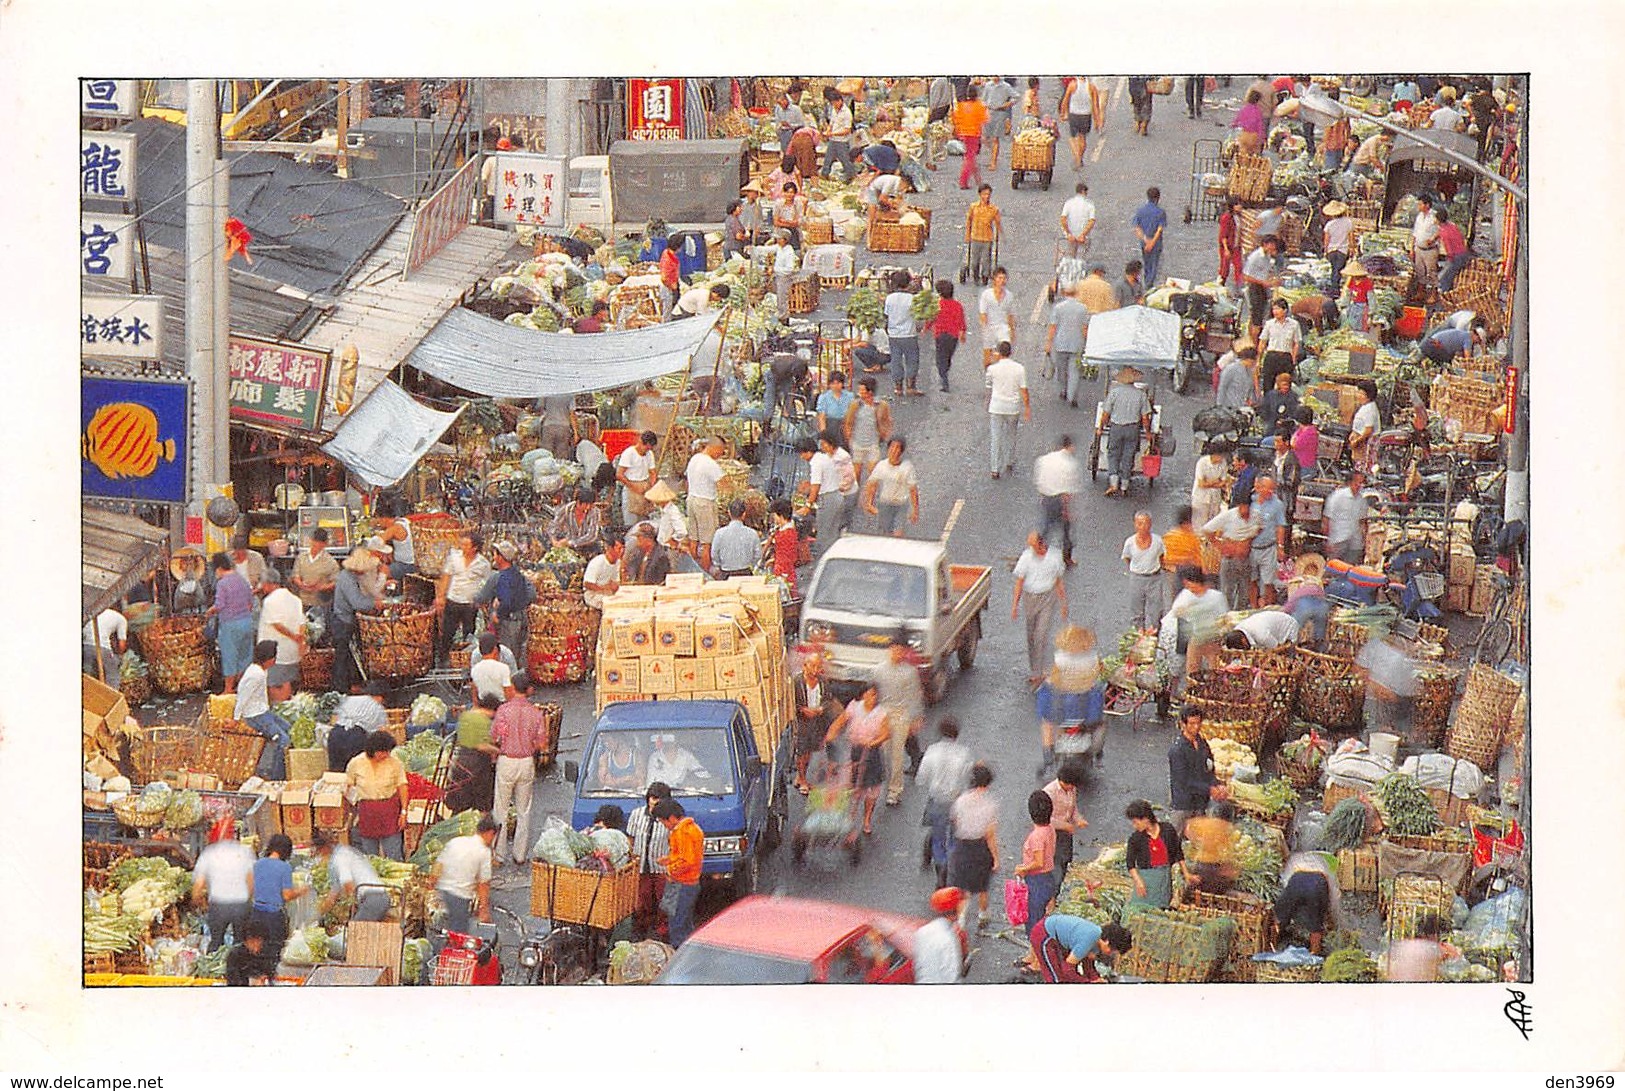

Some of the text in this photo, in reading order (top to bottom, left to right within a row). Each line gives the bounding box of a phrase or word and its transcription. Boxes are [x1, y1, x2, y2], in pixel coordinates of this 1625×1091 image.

[643, 85, 671, 122] 園
[503, 169, 519, 211] 機車
[522, 172, 537, 212] 修理
